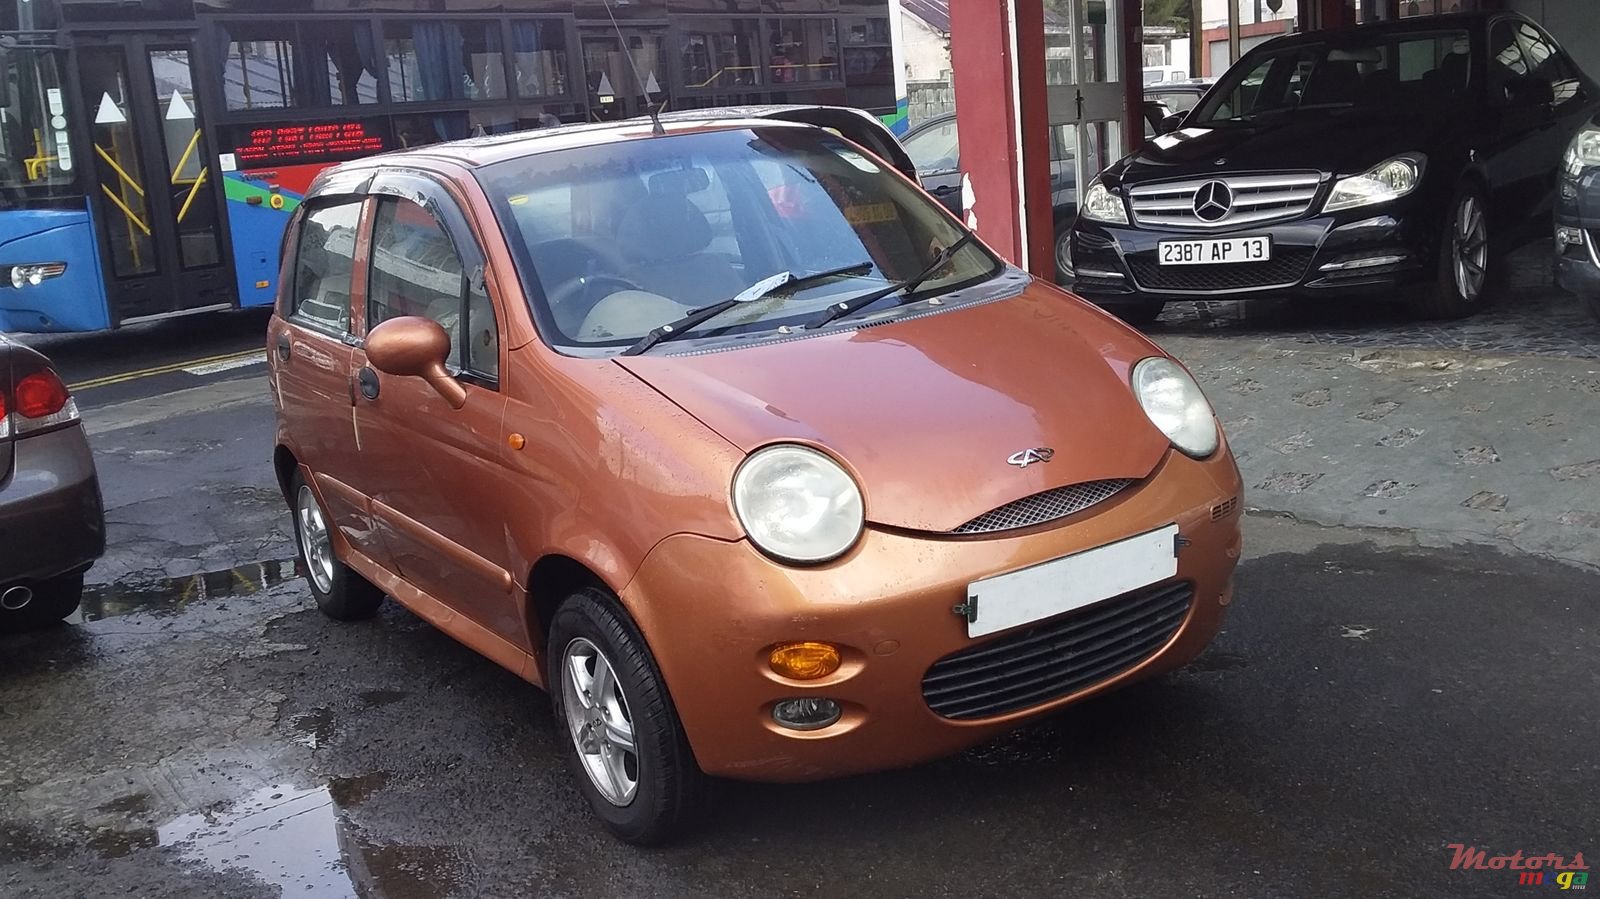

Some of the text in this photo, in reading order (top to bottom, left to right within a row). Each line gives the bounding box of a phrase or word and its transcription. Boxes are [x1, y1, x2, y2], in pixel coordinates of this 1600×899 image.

[1164, 240, 1263, 262] 2387 AP 13
